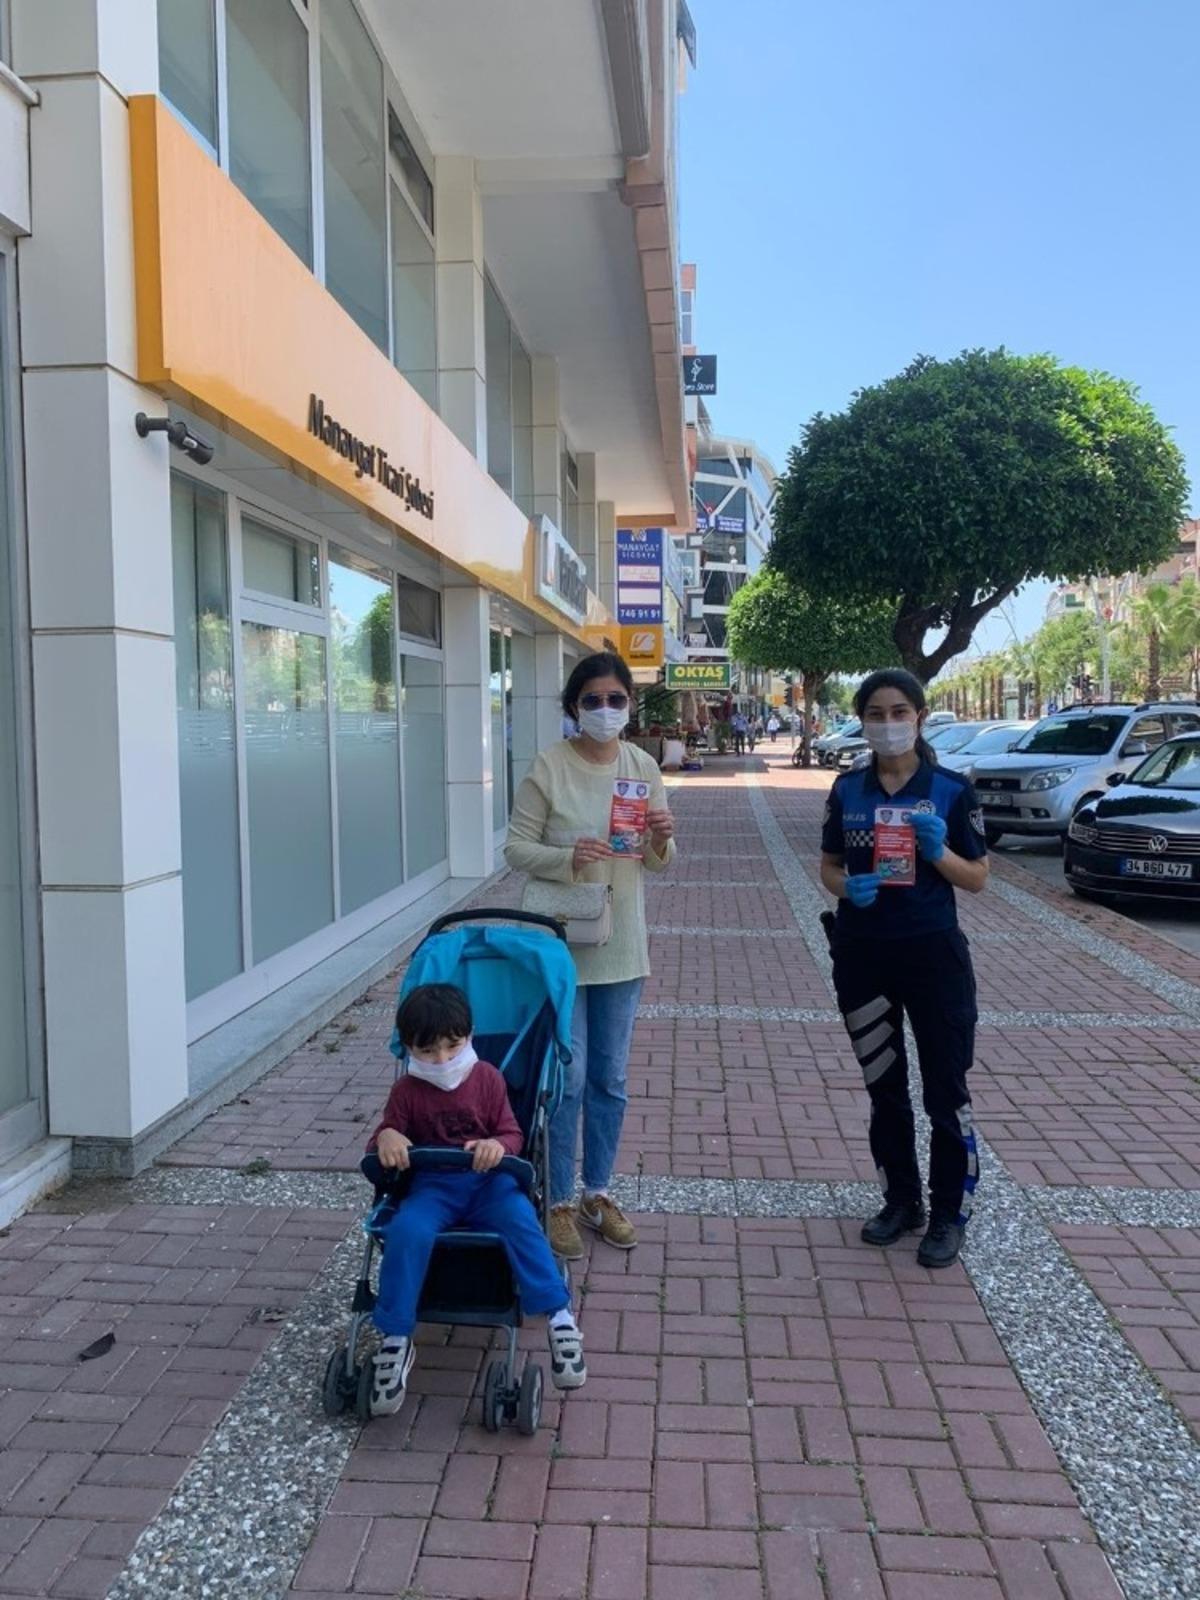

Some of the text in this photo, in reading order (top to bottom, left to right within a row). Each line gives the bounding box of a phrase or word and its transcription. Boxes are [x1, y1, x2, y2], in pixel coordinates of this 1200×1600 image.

[308, 393, 434, 521] Manavgat Ticari Şubesi
[674, 666, 725, 681] OKTAŞ
[1127, 860, 1140, 872] 34
[1167, 863, 1190, 876] 477
